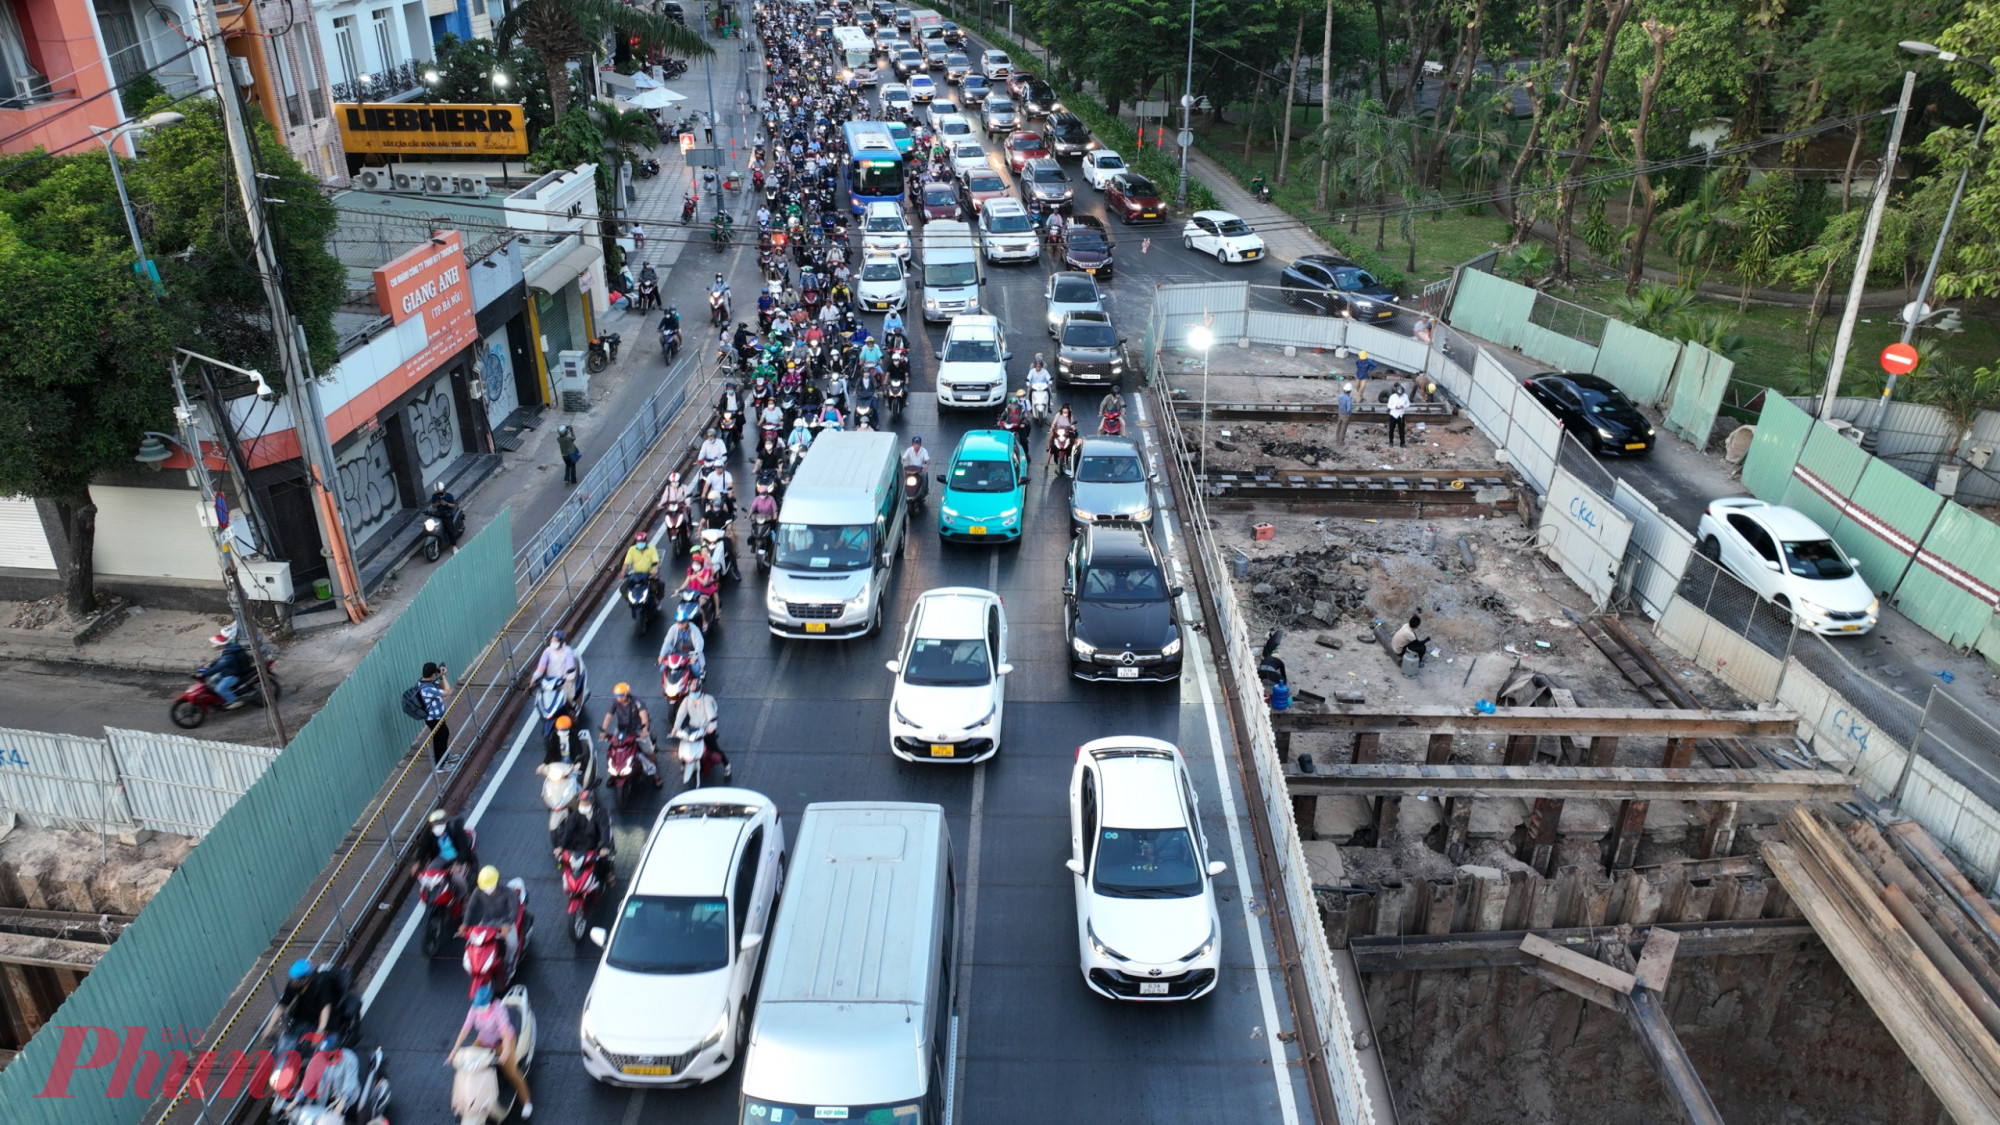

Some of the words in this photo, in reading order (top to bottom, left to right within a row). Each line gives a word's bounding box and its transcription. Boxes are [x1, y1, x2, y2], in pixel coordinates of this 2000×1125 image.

[346, 108, 515, 132] LIEBHERR
[402, 280, 437, 314] GIANG
[439, 265, 460, 293] ANH
[442, 296, 451, 312] HÀ
